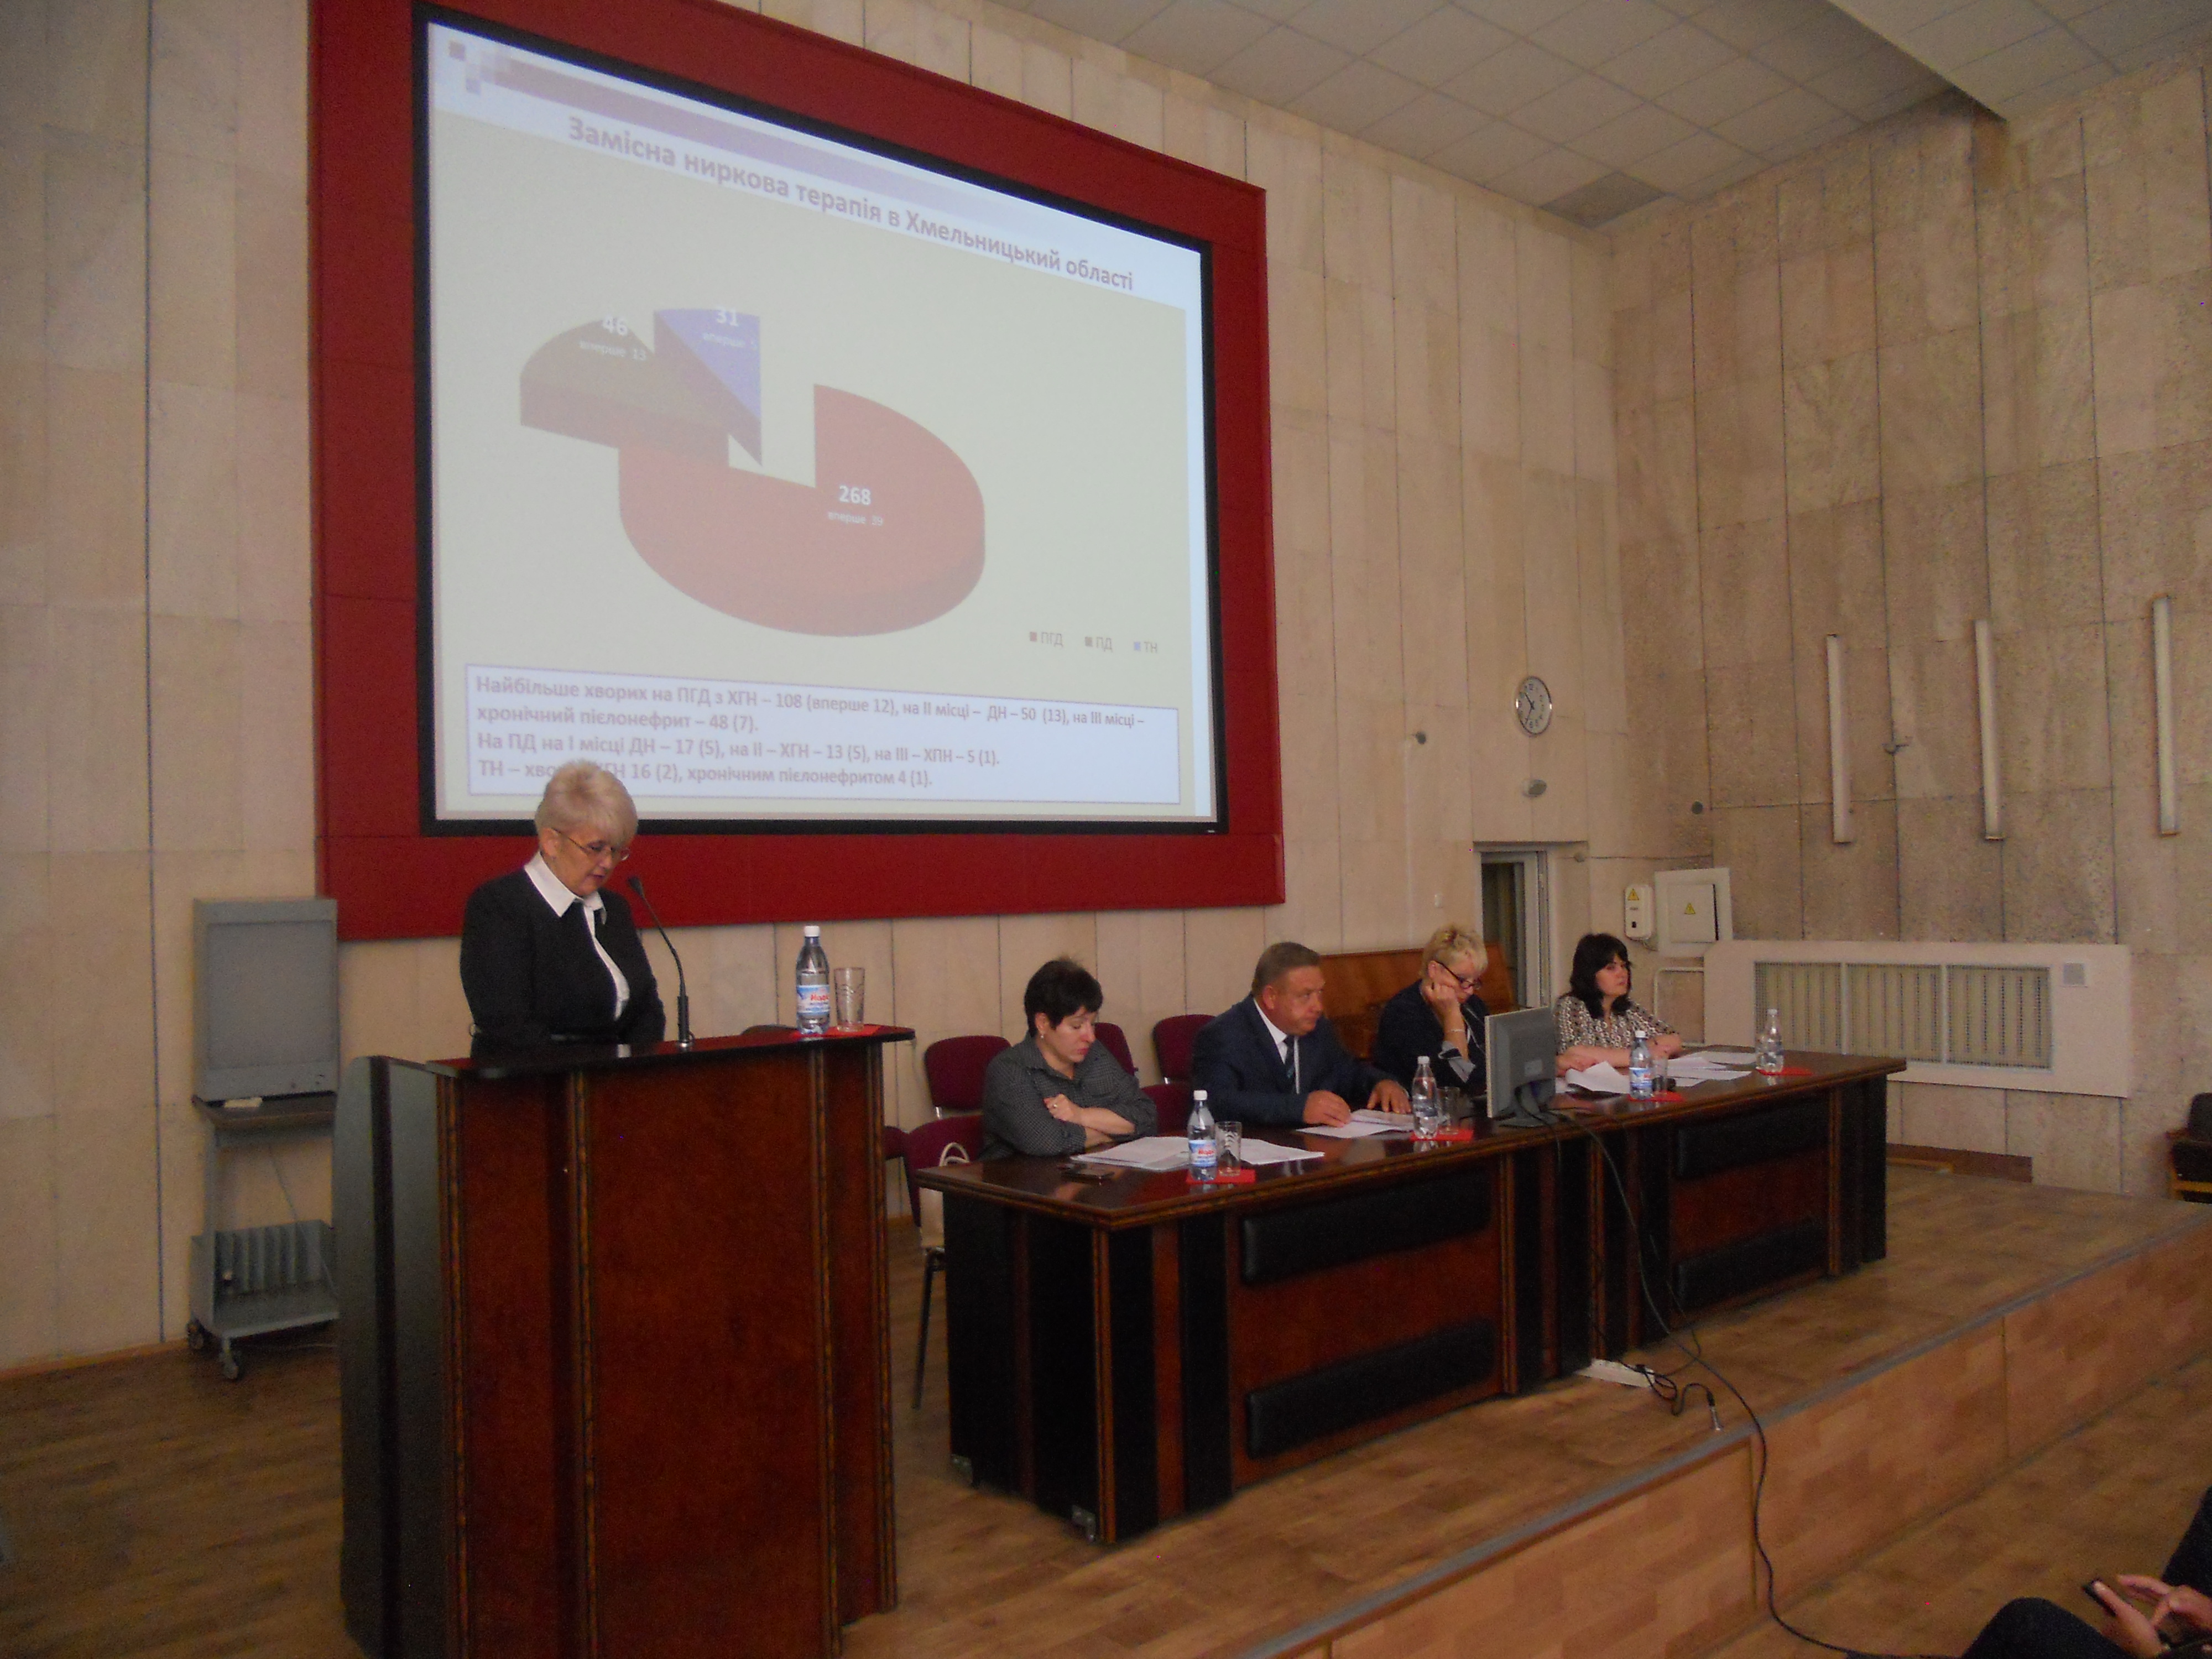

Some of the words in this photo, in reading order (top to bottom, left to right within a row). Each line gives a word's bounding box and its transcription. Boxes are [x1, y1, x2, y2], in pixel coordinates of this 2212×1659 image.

[569, 117, 676, 166] Замісна
[685, 154, 789, 197] ниркова
[796, 183, 881, 223] терапія
[889, 208, 900, 227] в
[907, 211, 1061, 270] Хмельницький
[1066, 259, 1133, 290] області
[602, 315, 628, 336] 46
[716, 307, 739, 327] 31
[839, 486, 871, 505] 268
[1041, 632, 1063, 648] ПГД
[1096, 637, 1113, 653] ПД
[1144, 641, 1157, 653] ТН
[477, 676, 579, 697] Найбільше
[585, 685, 647, 702] хворих
[653, 690, 672, 702] на
[677, 687, 711, 707] ПГД
[716, 693, 723, 704] з
[728, 690, 757, 706] ХГН
[776, 693, 802, 708] 108
[807, 695, 869, 713] (вперше
[875, 699, 899, 717] 12),
[903, 703, 919, 714] на
[936, 703, 969, 720] місці
[988, 706, 1006, 722] ДН
[1022, 708, 1036, 720] 50
[1043, 708, 1068, 725] (13),
[1073, 713, 1087, 723] на
[1105, 713, 1134, 728] місці
[478, 706, 575, 723] хронічний
[581, 708, 691, 730] пієлонефрит
[709, 715, 728, 729] 48
[733, 715, 758, 733] (7).
[478, 733, 502, 749] На
[508, 733, 536, 753] ПД
[542, 738, 563, 750] на
[581, 737, 624, 755] місці
[629, 738, 655, 755] ДН
[676, 739, 693, 754] 17
[700, 739, 724, 759] (5),
[730, 744, 749, 756] на
[780, 743, 808, 758] ХГН
[827, 744, 842, 759] 13
[848, 745, 870, 763] (5),
[875, 749, 891, 760] на
[924, 749, 952, 762] ХПН
[968, 750, 974, 763] 5
[979, 750, 999, 766] (1).
[479, 760, 503, 776] ТН
[632, 764, 651, 779] 16
[656, 763, 682, 783] (2),
[687, 766, 774, 783] хронічним
[780, 768, 894, 786] пієлонефритом
[898, 771, 906, 784] 4
[911, 770, 932, 787] (1).
